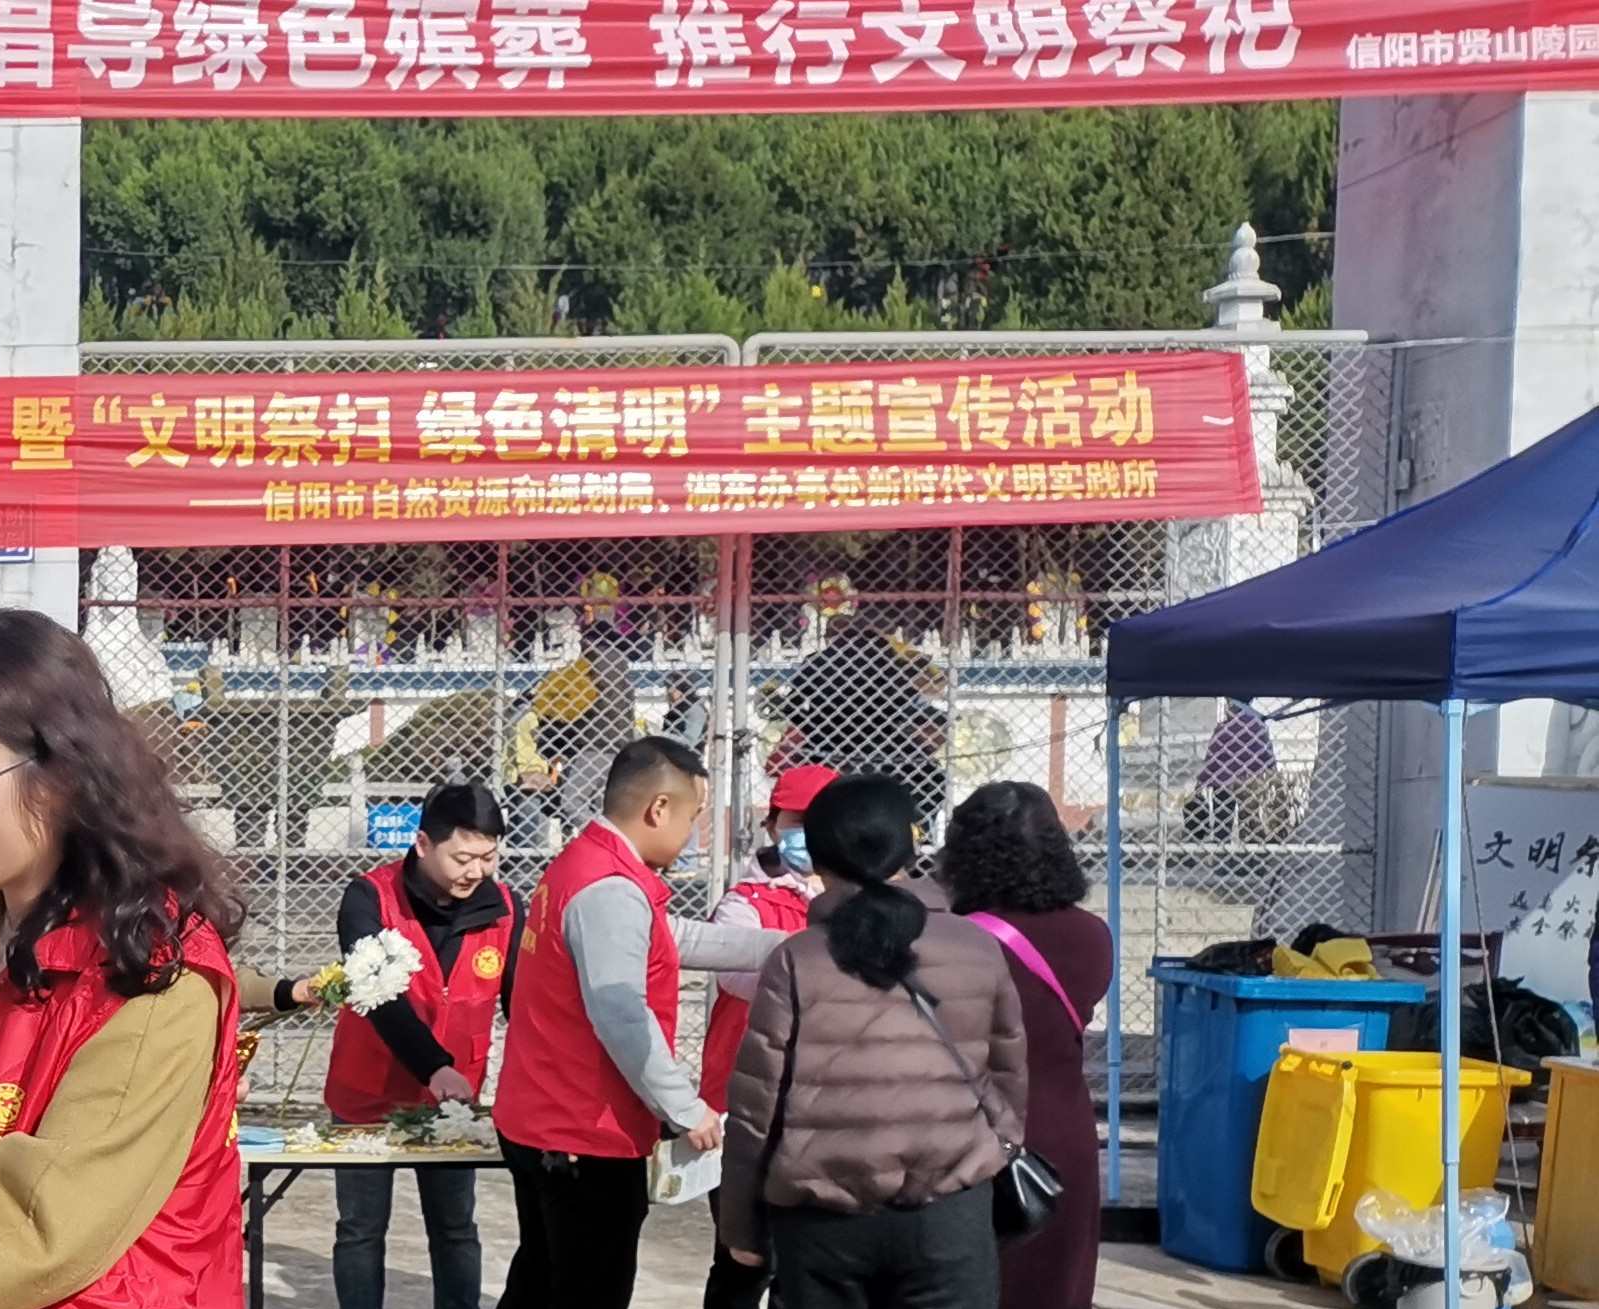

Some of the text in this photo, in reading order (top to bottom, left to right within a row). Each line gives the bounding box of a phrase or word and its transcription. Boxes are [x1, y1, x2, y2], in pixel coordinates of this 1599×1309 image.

[1346, 24, 1599, 69] 信阳市贤山陵园
